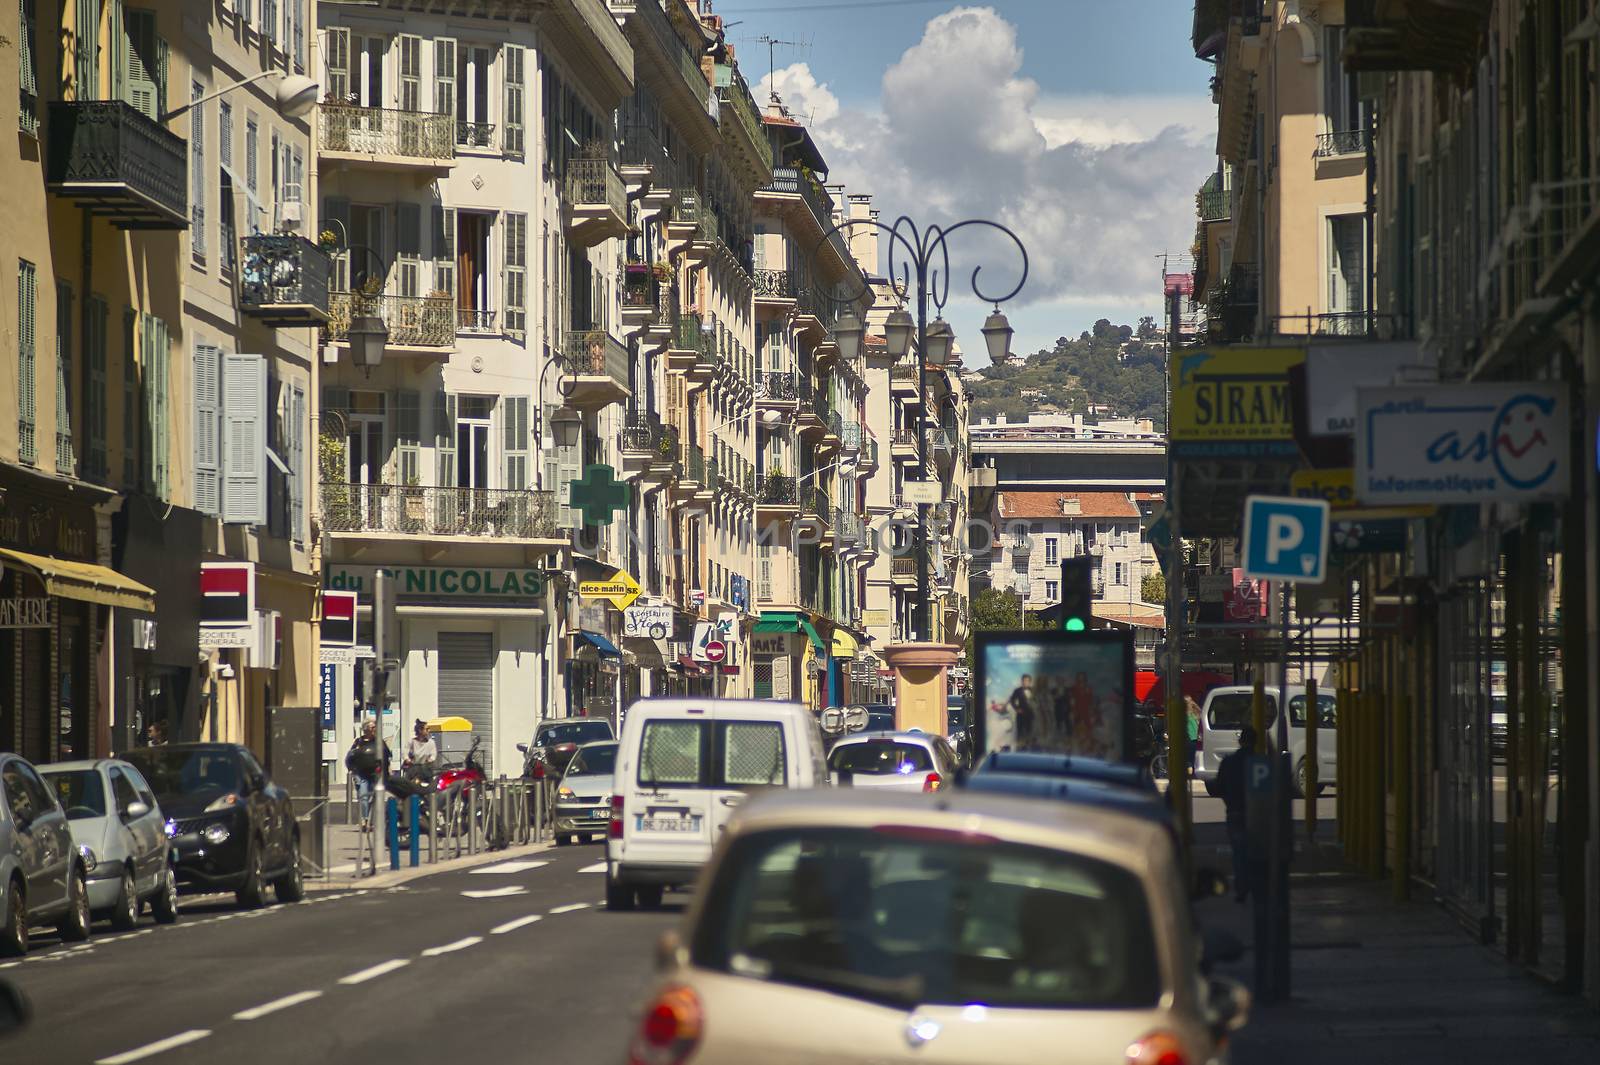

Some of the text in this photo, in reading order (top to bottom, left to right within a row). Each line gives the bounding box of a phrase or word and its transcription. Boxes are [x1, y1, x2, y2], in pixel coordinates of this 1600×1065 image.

[1265, 513, 1305, 565] P
[331, 570, 363, 591] du
[405, 569, 541, 595] NICOLAS
[1253, 763, 1270, 788] P
